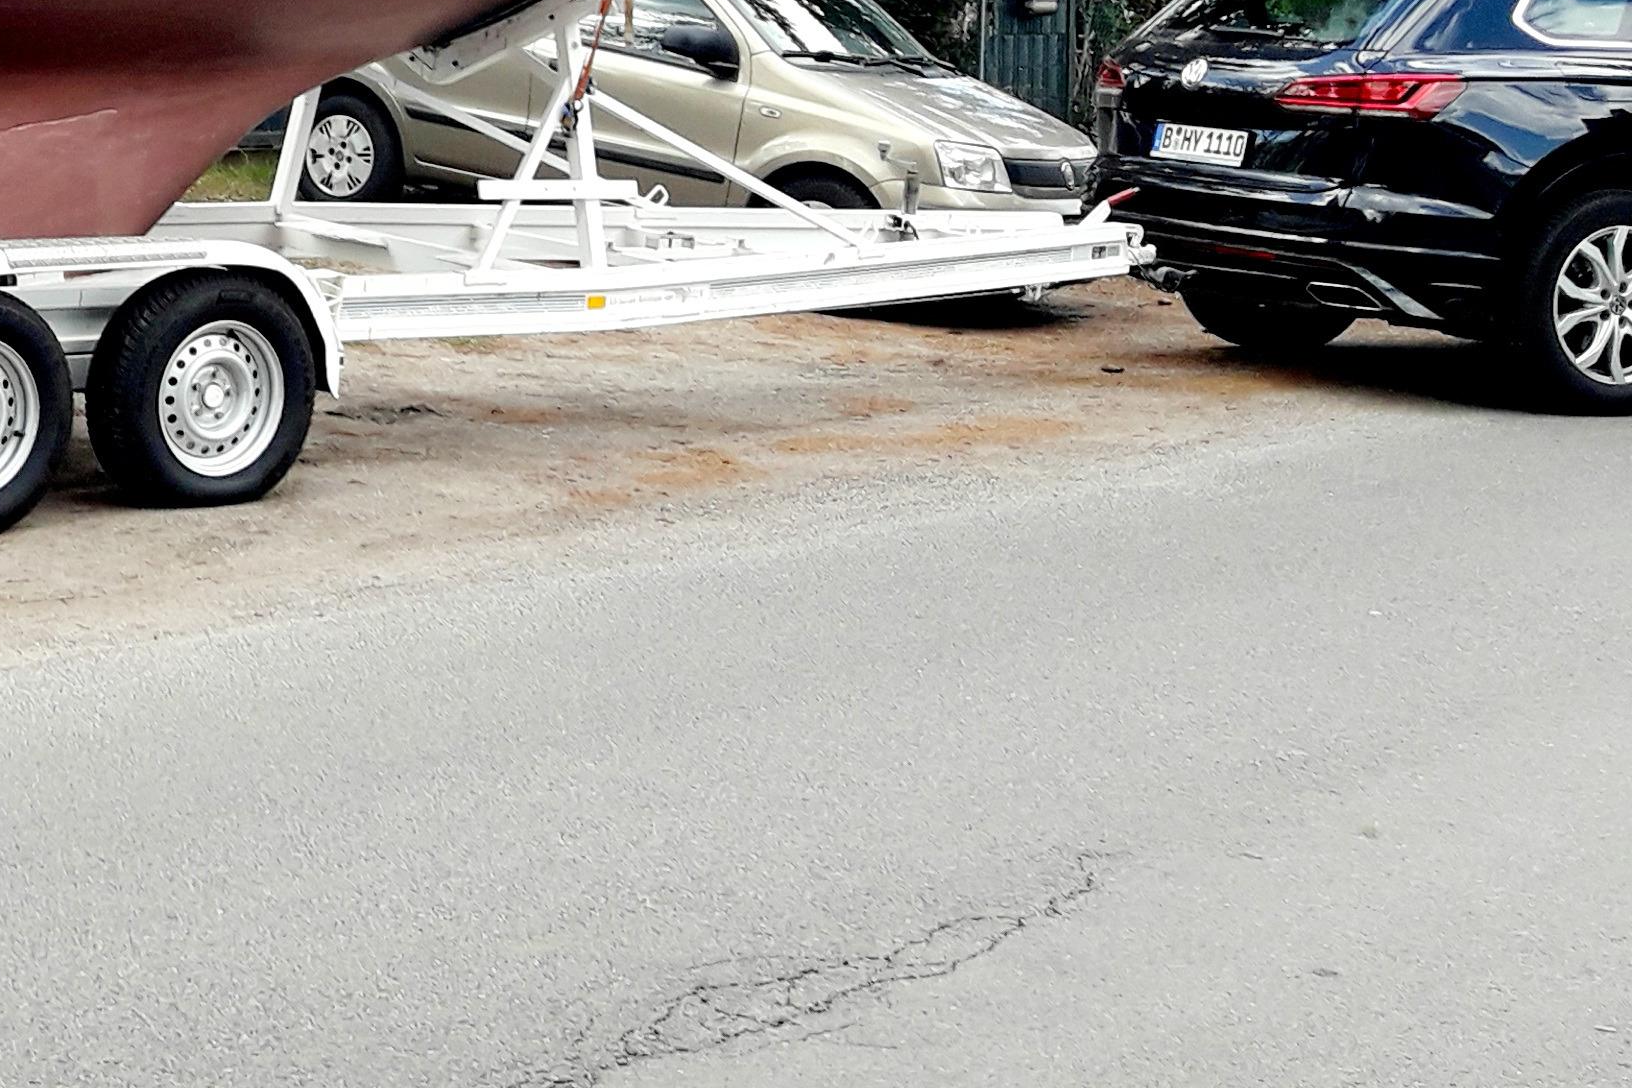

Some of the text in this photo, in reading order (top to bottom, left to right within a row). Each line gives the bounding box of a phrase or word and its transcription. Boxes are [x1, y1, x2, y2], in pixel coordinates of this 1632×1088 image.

[1162, 127, 1245, 157] B HY 1110
